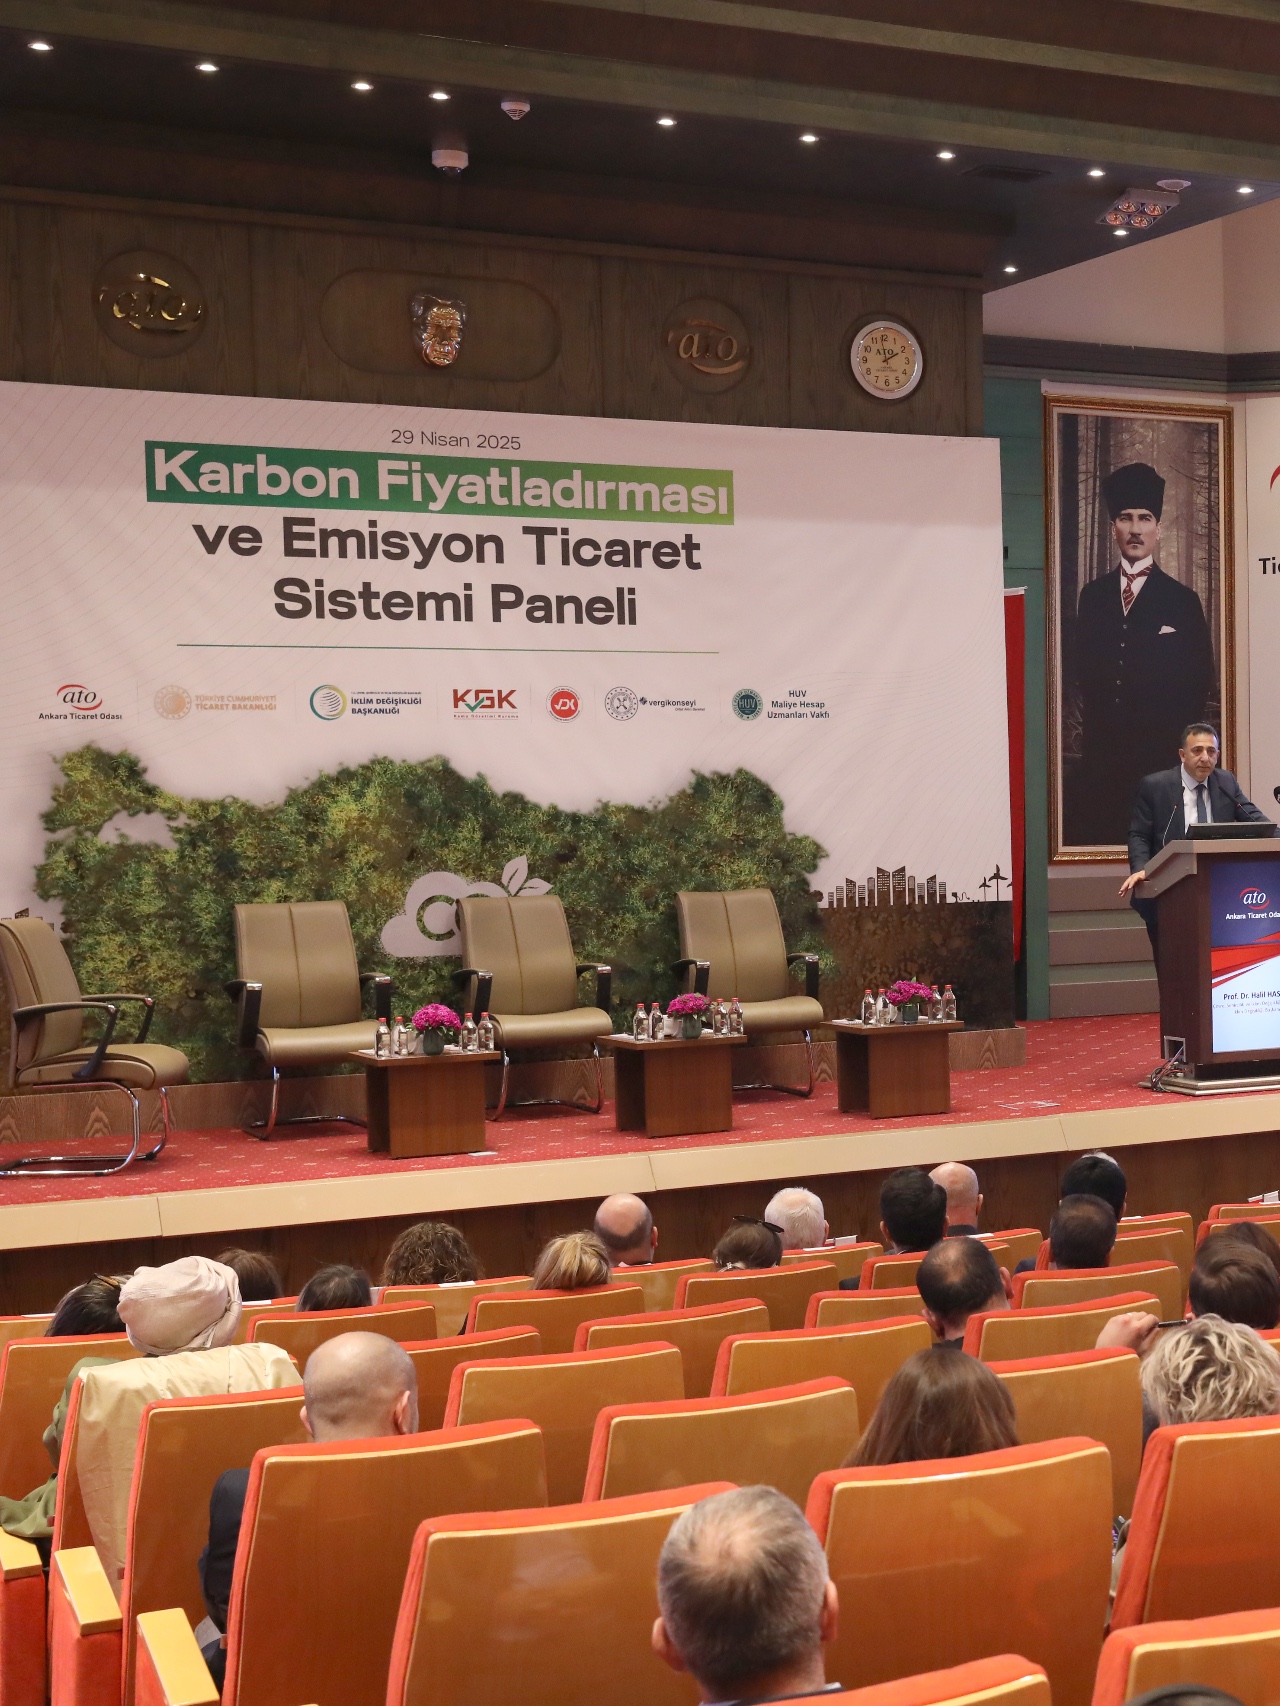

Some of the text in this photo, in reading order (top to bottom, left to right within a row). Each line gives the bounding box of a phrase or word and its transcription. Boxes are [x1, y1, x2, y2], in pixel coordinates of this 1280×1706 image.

[862, 356, 868, 364] 9
[905, 357, 910, 365] 3
[866, 368, 871, 376] 8
[885, 379, 890, 387] 6
[391, 429, 521, 450] 29 Nisan 2025
[154, 448, 728, 515] Karbon Fiyatladırması
[191, 516, 702, 571] ve Emisyon Ticaret
[273, 577, 637, 626] Sistemi Paneli
[62, 690, 97, 704] ato
[788, 689, 807, 698] HUV
[351, 696, 422, 706] İKLİM DEĞİŞİKLİĞİ
[452, 688, 518, 711] KGK
[648, 699, 697, 708] vergikonseyi
[739, 698, 756, 709] HUV
[195, 702, 277, 711] TİCARET BAKANLIĞI
[771, 700, 826, 709] Maliye Hesap
[38, 712, 122, 720] Ankara Ticaret Odası
[351, 707, 400, 716] BAŞKANLIĞI
[767, 710, 830, 719] Uzmanları Vakfı
[1243, 890, 1267, 905] ato
[1223, 993, 1239, 1001] Prof.
[1240, 992, 1250, 1000] Dr.
[1251, 991, 1266, 999] Halil
